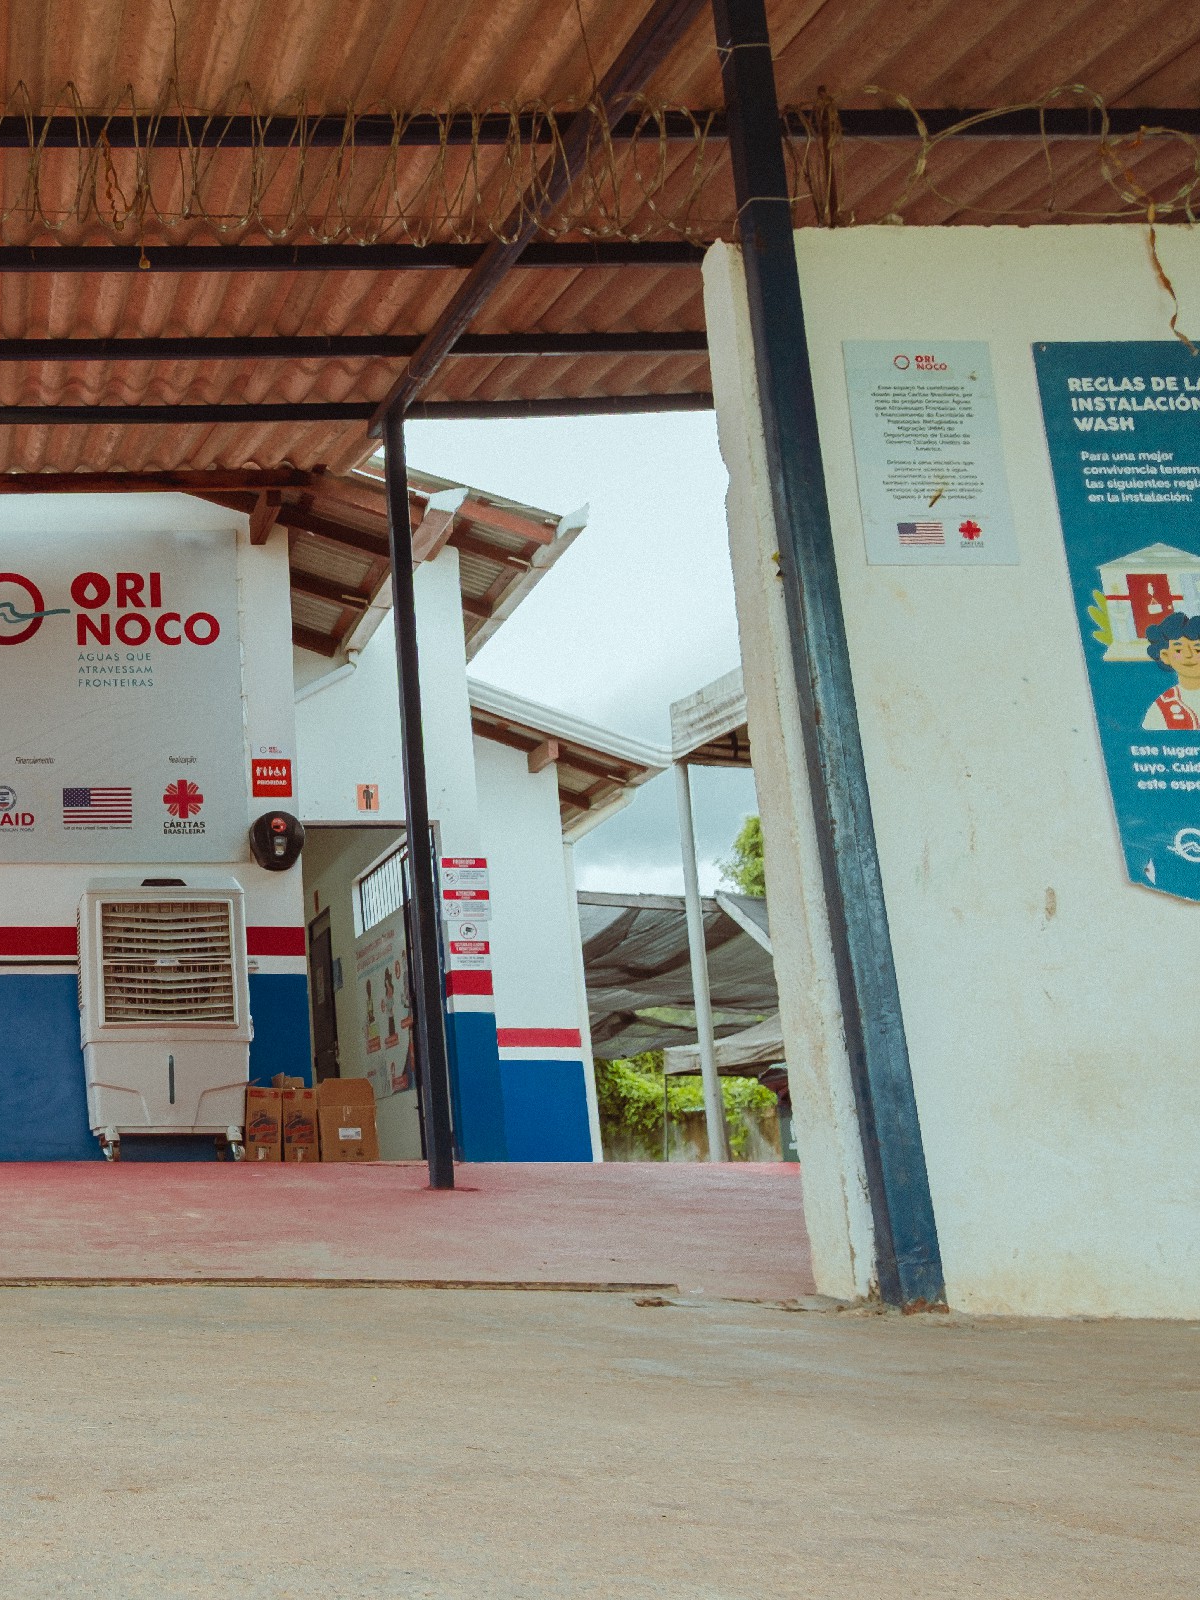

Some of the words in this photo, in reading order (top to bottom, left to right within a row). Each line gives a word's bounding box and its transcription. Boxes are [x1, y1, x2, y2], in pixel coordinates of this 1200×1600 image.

[915, 355, 934, 363] ORI
[1067, 376, 1146, 392] REGLAS
[1151, 376, 1179, 391] DE
[1183, 377, 1200, 391] L
[1071, 393, 1200, 412] INSTALACIÓN
[1073, 417, 1135, 431] WASH
[1081, 450, 1110, 461] Para
[1112, 452, 1136, 461] una
[1138, 450, 1174, 463] mejor
[1083, 464, 1158, 475] convivencia
[1085, 479, 1104, 489] las
[1106, 478, 1172, 490] siguientes
[1173, 478, 1200, 490] regl
[1088, 494, 1104, 502] en
[1107, 492, 1120, 502] la
[70, 571, 162, 609] ORI
[76, 612, 221, 646] NOCO
[126, 652, 152, 661] QUE
[78, 665, 153, 674] ATRAVESSAM
[78, 679, 154, 687] FRONTEIRAS
[1130, 745, 1159, 756] Este
[1162, 745, 1200, 758] lugar
[1133, 762, 1170, 775] tuyo.
[1137, 779, 1167, 790] este
[163, 819, 206, 828] CÁRITAS
